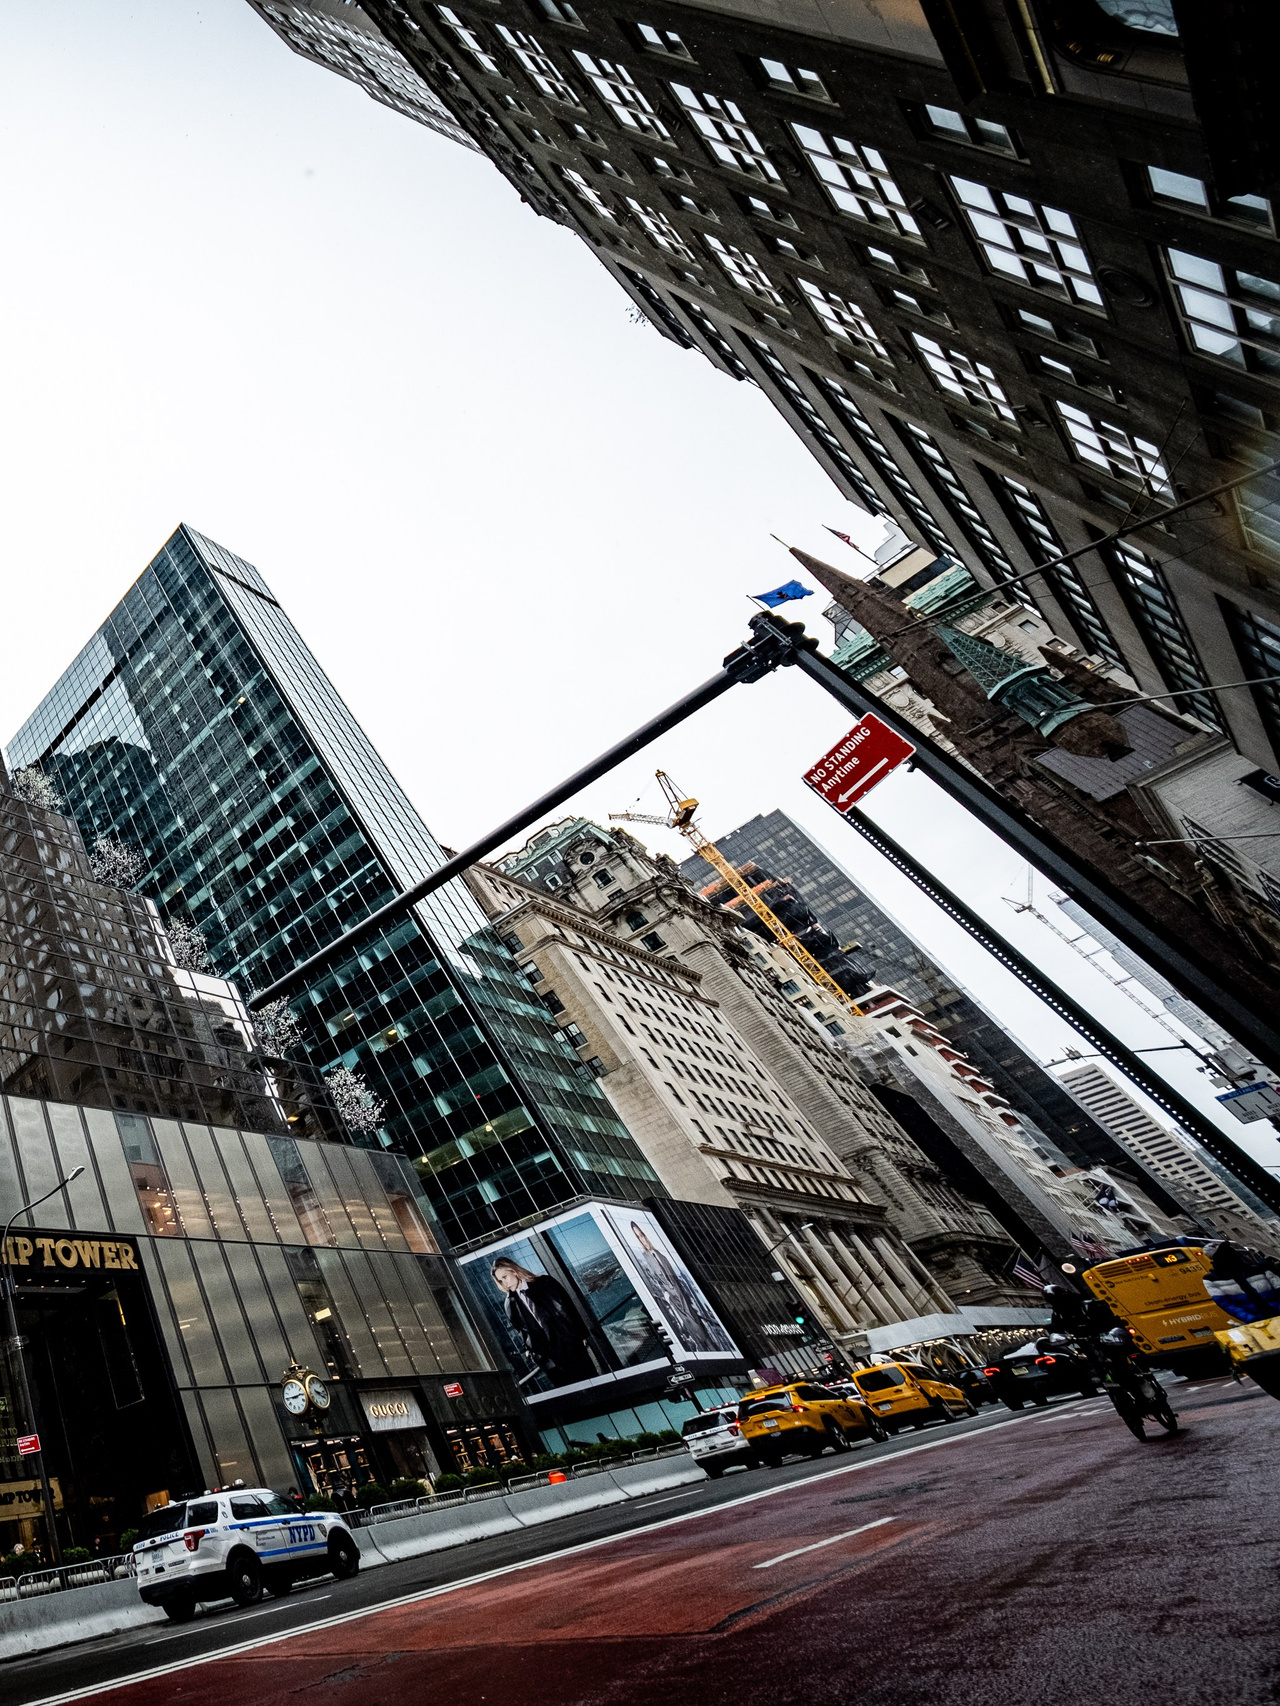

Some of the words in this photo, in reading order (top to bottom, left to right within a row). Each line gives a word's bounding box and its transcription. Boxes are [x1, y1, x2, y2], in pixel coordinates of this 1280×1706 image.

[810, 769, 826, 784] NO
[824, 727, 871, 771] STANDING
[821, 757, 860, 792] Anytime
[35, 1237, 138, 1270] TOWER
[1179, 1262, 1203, 1275] 9435
[1187, 1291, 1201, 1299] bus
[370, 1402, 409, 1417] GUCCI
[160, 1532, 179, 1541] POLICE
[288, 1524, 315, 1544] NYPD
